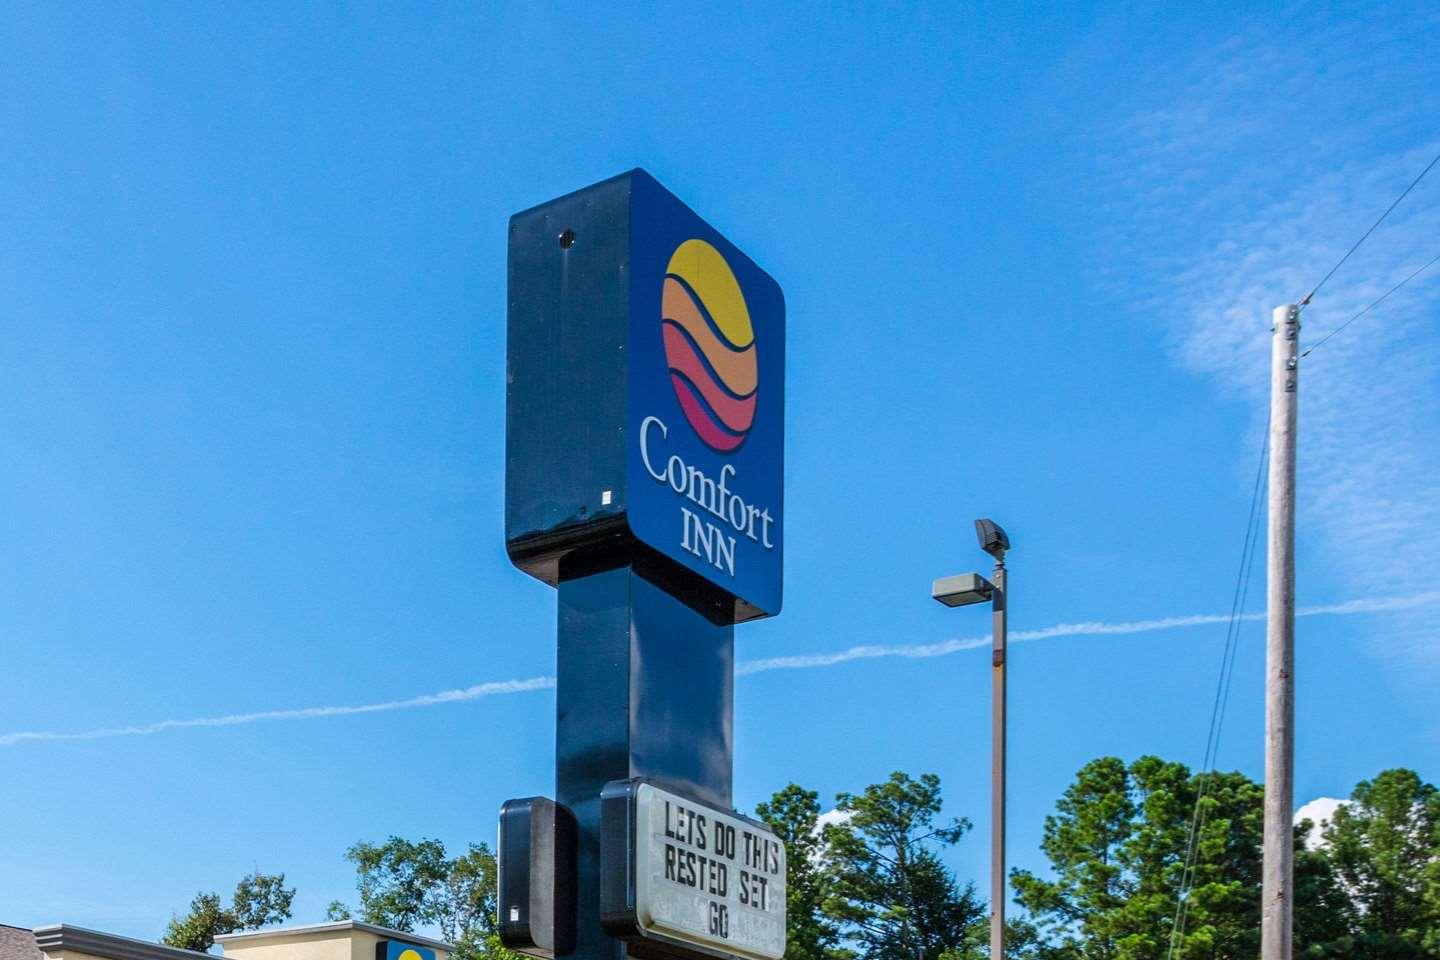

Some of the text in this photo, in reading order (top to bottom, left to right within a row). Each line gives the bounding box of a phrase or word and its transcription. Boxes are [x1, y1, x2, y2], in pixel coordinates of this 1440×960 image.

[640, 416, 774, 549] Comfort
[680, 507, 736, 577] INN
[666, 801, 779, 875] LETS DO THIS
[665, 843, 768, 910] RESTED SET
[709, 900, 729, 939] GO
